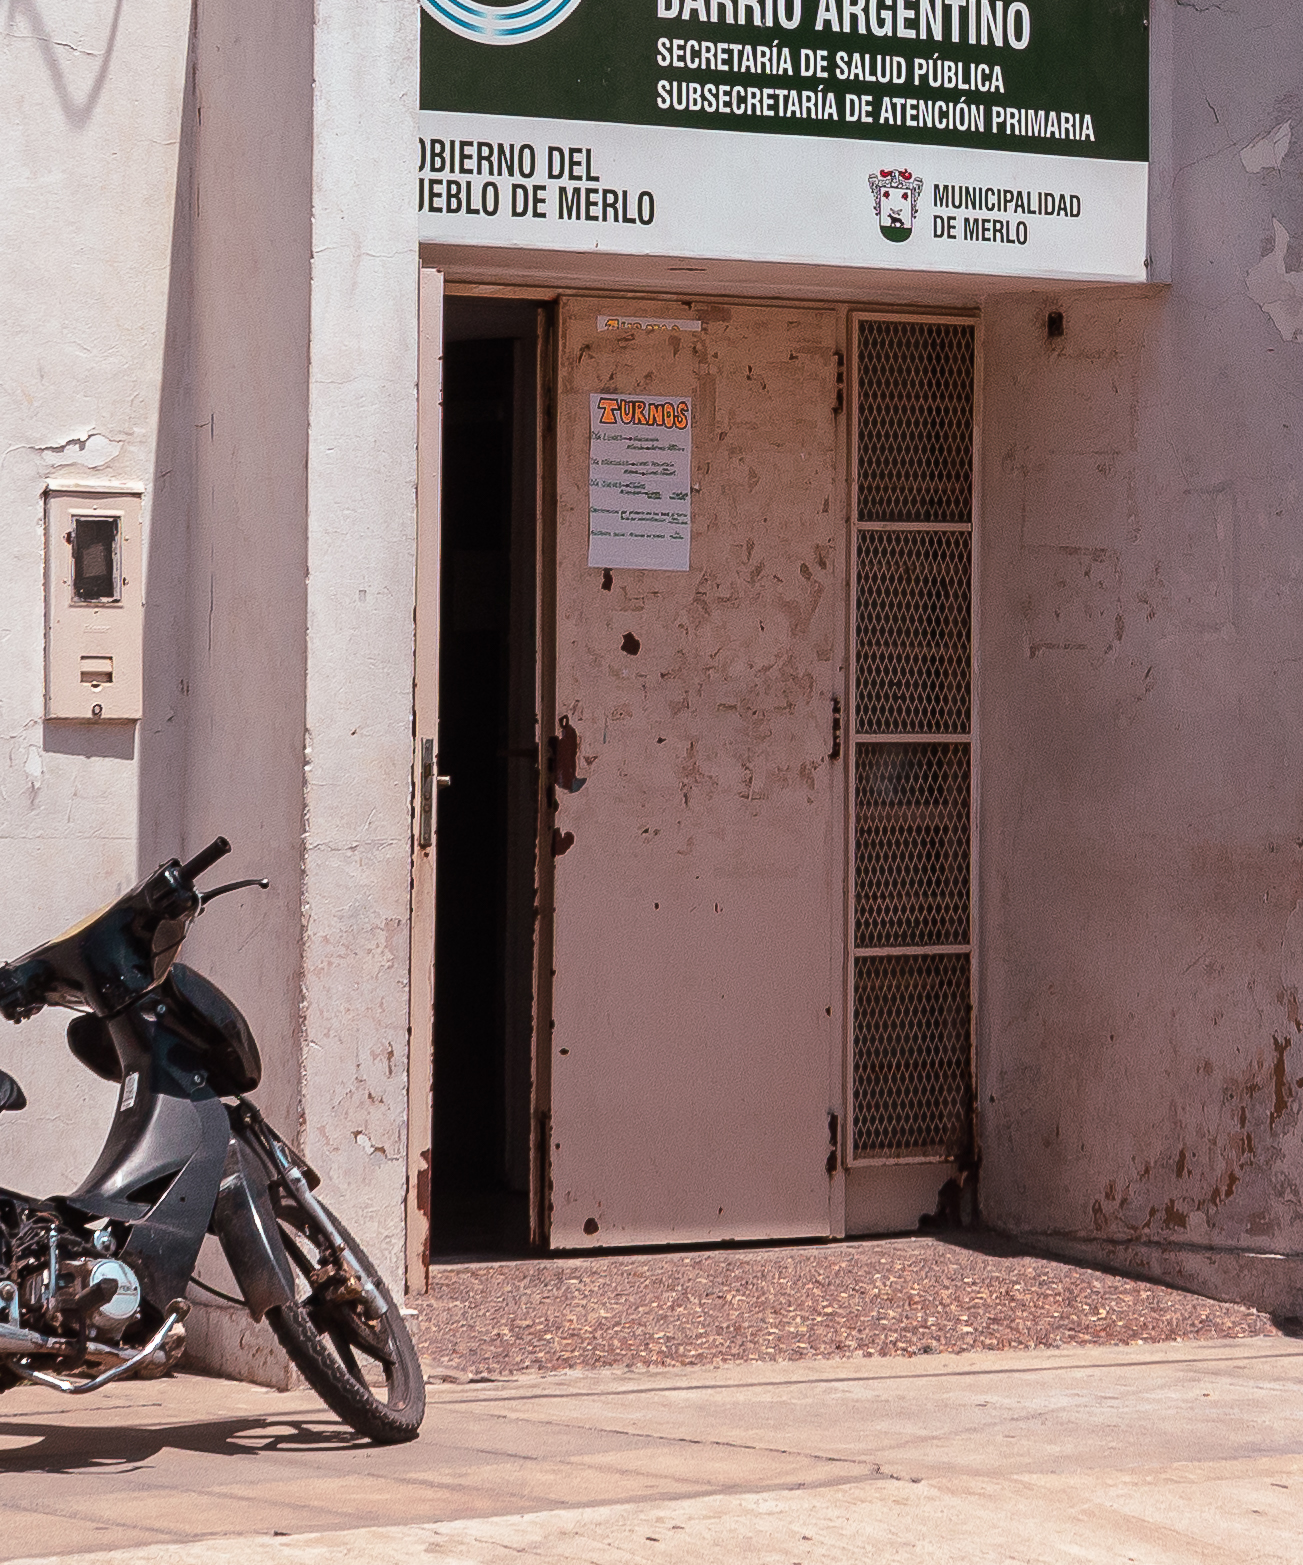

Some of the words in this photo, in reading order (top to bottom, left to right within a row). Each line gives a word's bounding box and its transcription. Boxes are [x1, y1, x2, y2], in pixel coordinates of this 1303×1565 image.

[656, 37, 794, 77] SECRETARÍA
[800, 48, 829, 79] DE
[835, 50, 907, 86] SALUD
[913, 52, 1006, 94] PÚBLICA
[656, 79, 839, 122] SUBSECRETARÍA
[845, 93, 874, 124] DE
[878, 96, 985, 133] ATENCIÓN
[991, 105, 1096, 142] PRIMARIA
[418, 136, 537, 179] BIERNO
[546, 145, 601, 183] DEL
[418, 177, 501, 217] EBLO
[510, 182, 547, 219] DE
[557, 185, 656, 226] MERLO
[932, 183, 1082, 218] MUNICIPALIDAD
[932, 214, 958, 240] DE
[963, 216, 1029, 246] MERLO
[597, 396, 690, 431] TURNOS
